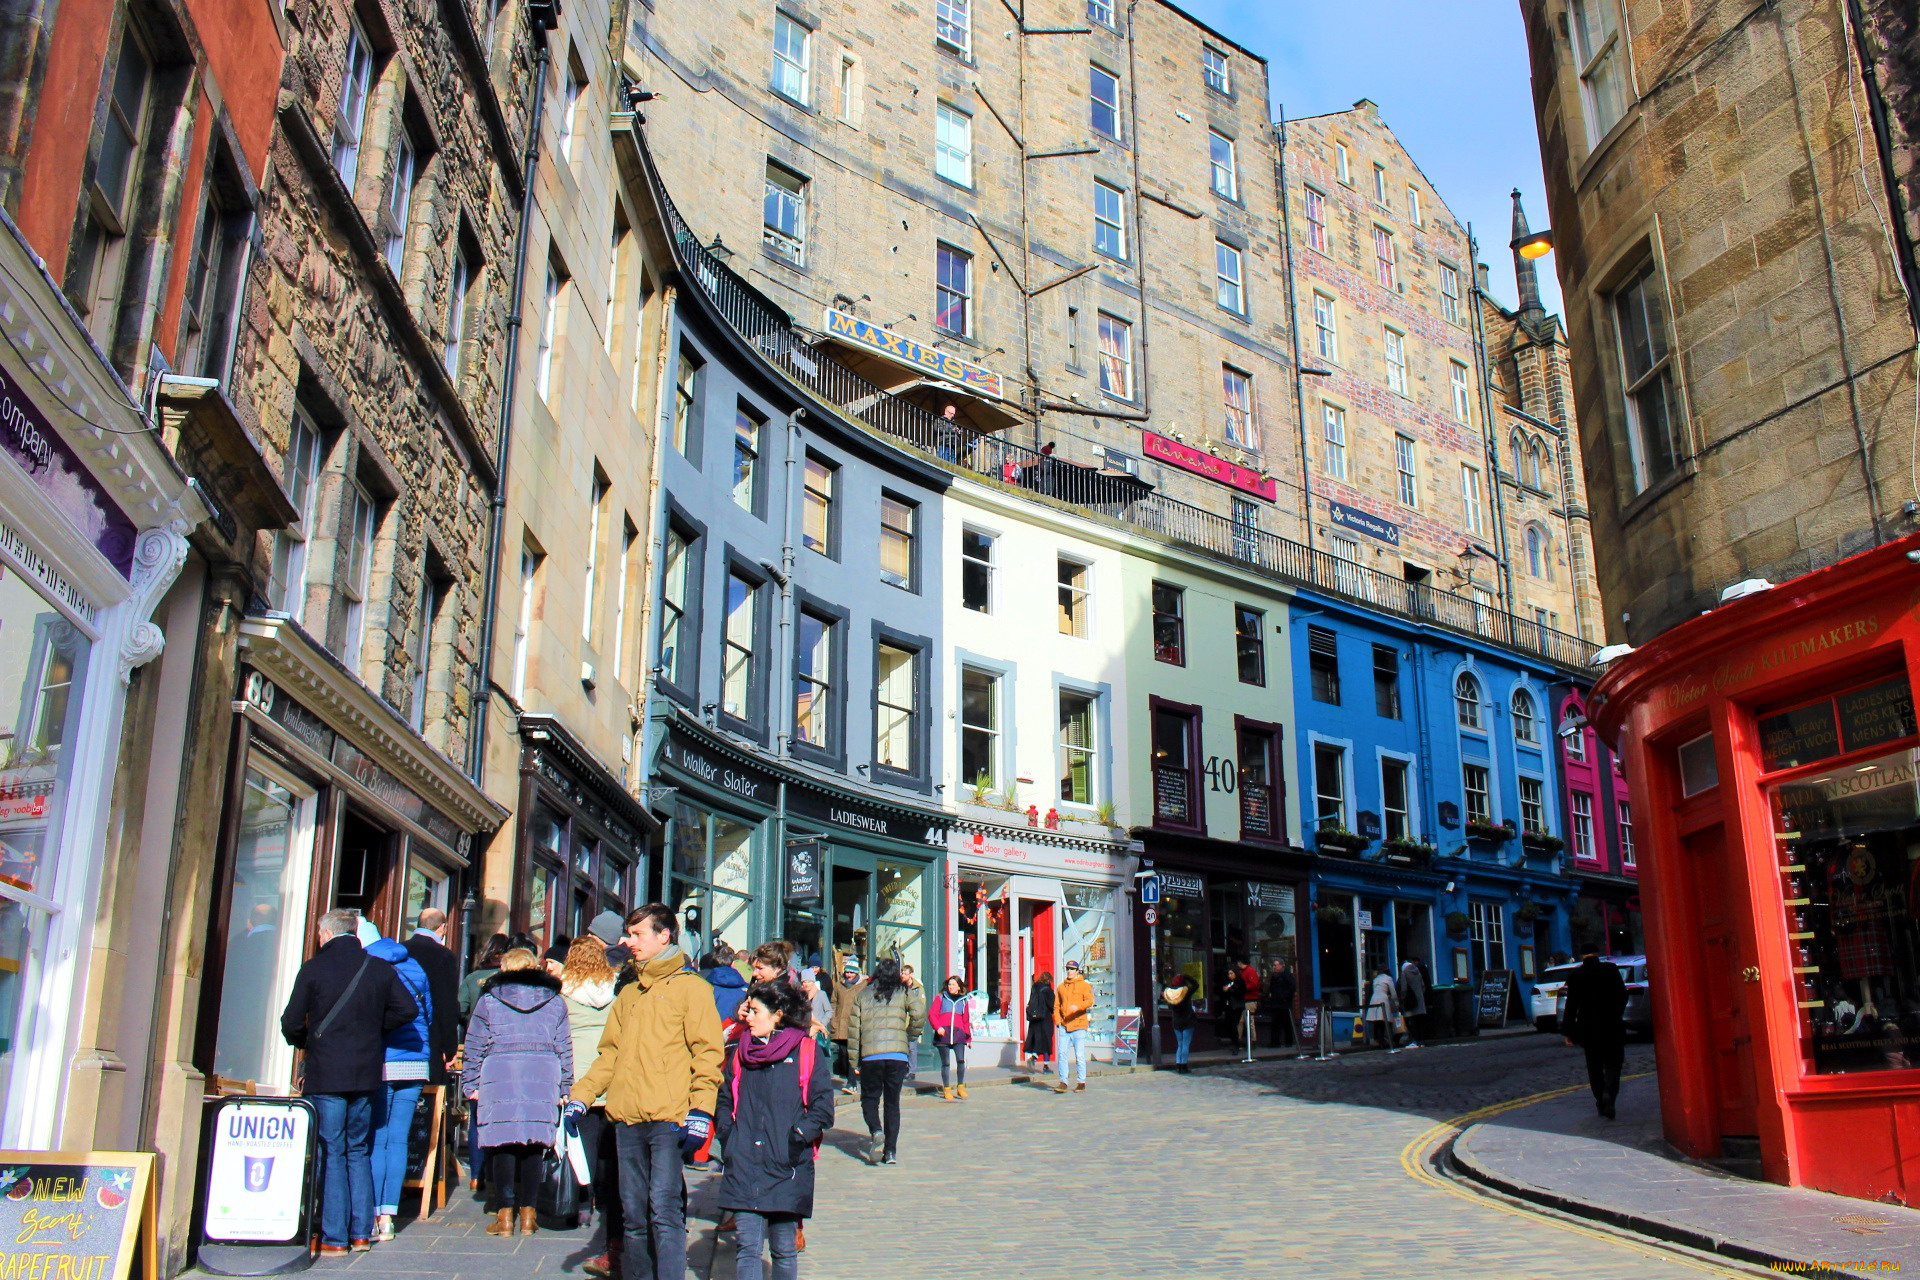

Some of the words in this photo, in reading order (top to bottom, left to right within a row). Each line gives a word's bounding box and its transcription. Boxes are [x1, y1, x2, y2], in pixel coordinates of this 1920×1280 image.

[831, 313, 965, 380] MAXIES
[1345, 512, 1366, 527] Victoria
[1365, 520, 1385, 534] Regalia
[1668, 674, 1709, 711] Victor
[1712, 661, 1757, 696] Scott
[1761, 615, 1880, 669] KILTMAKERS
[248, 671, 274, 714] 89
[1844, 690, 1883, 713] LADIES
[1853, 708, 1881, 726] KIDS
[1881, 700, 1911, 719] KILTS
[1795, 718, 1829, 740] HEAVY
[1851, 725, 1885, 743] MENS
[1762, 738, 1801, 762] WEIGHT
[1804, 731, 1839, 750] WOOL
[683, 750, 717, 782] Walker
[723, 770, 758, 798] Slater
[1203, 756, 1235, 794] 40
[830, 807, 887, 834] LADIESWEAR
[456, 831, 472, 858] 89
[962, 840, 974, 850] the
[984, 843, 1000, 853] door
[1003, 847, 1027, 860] gallery
[791, 876, 813, 885] Walker
[791, 884, 813, 893] Slater
[1146, 912, 1156, 920] 20
[229, 1115, 296, 1140] UNION
[33, 1176, 90, 1202] NEW
